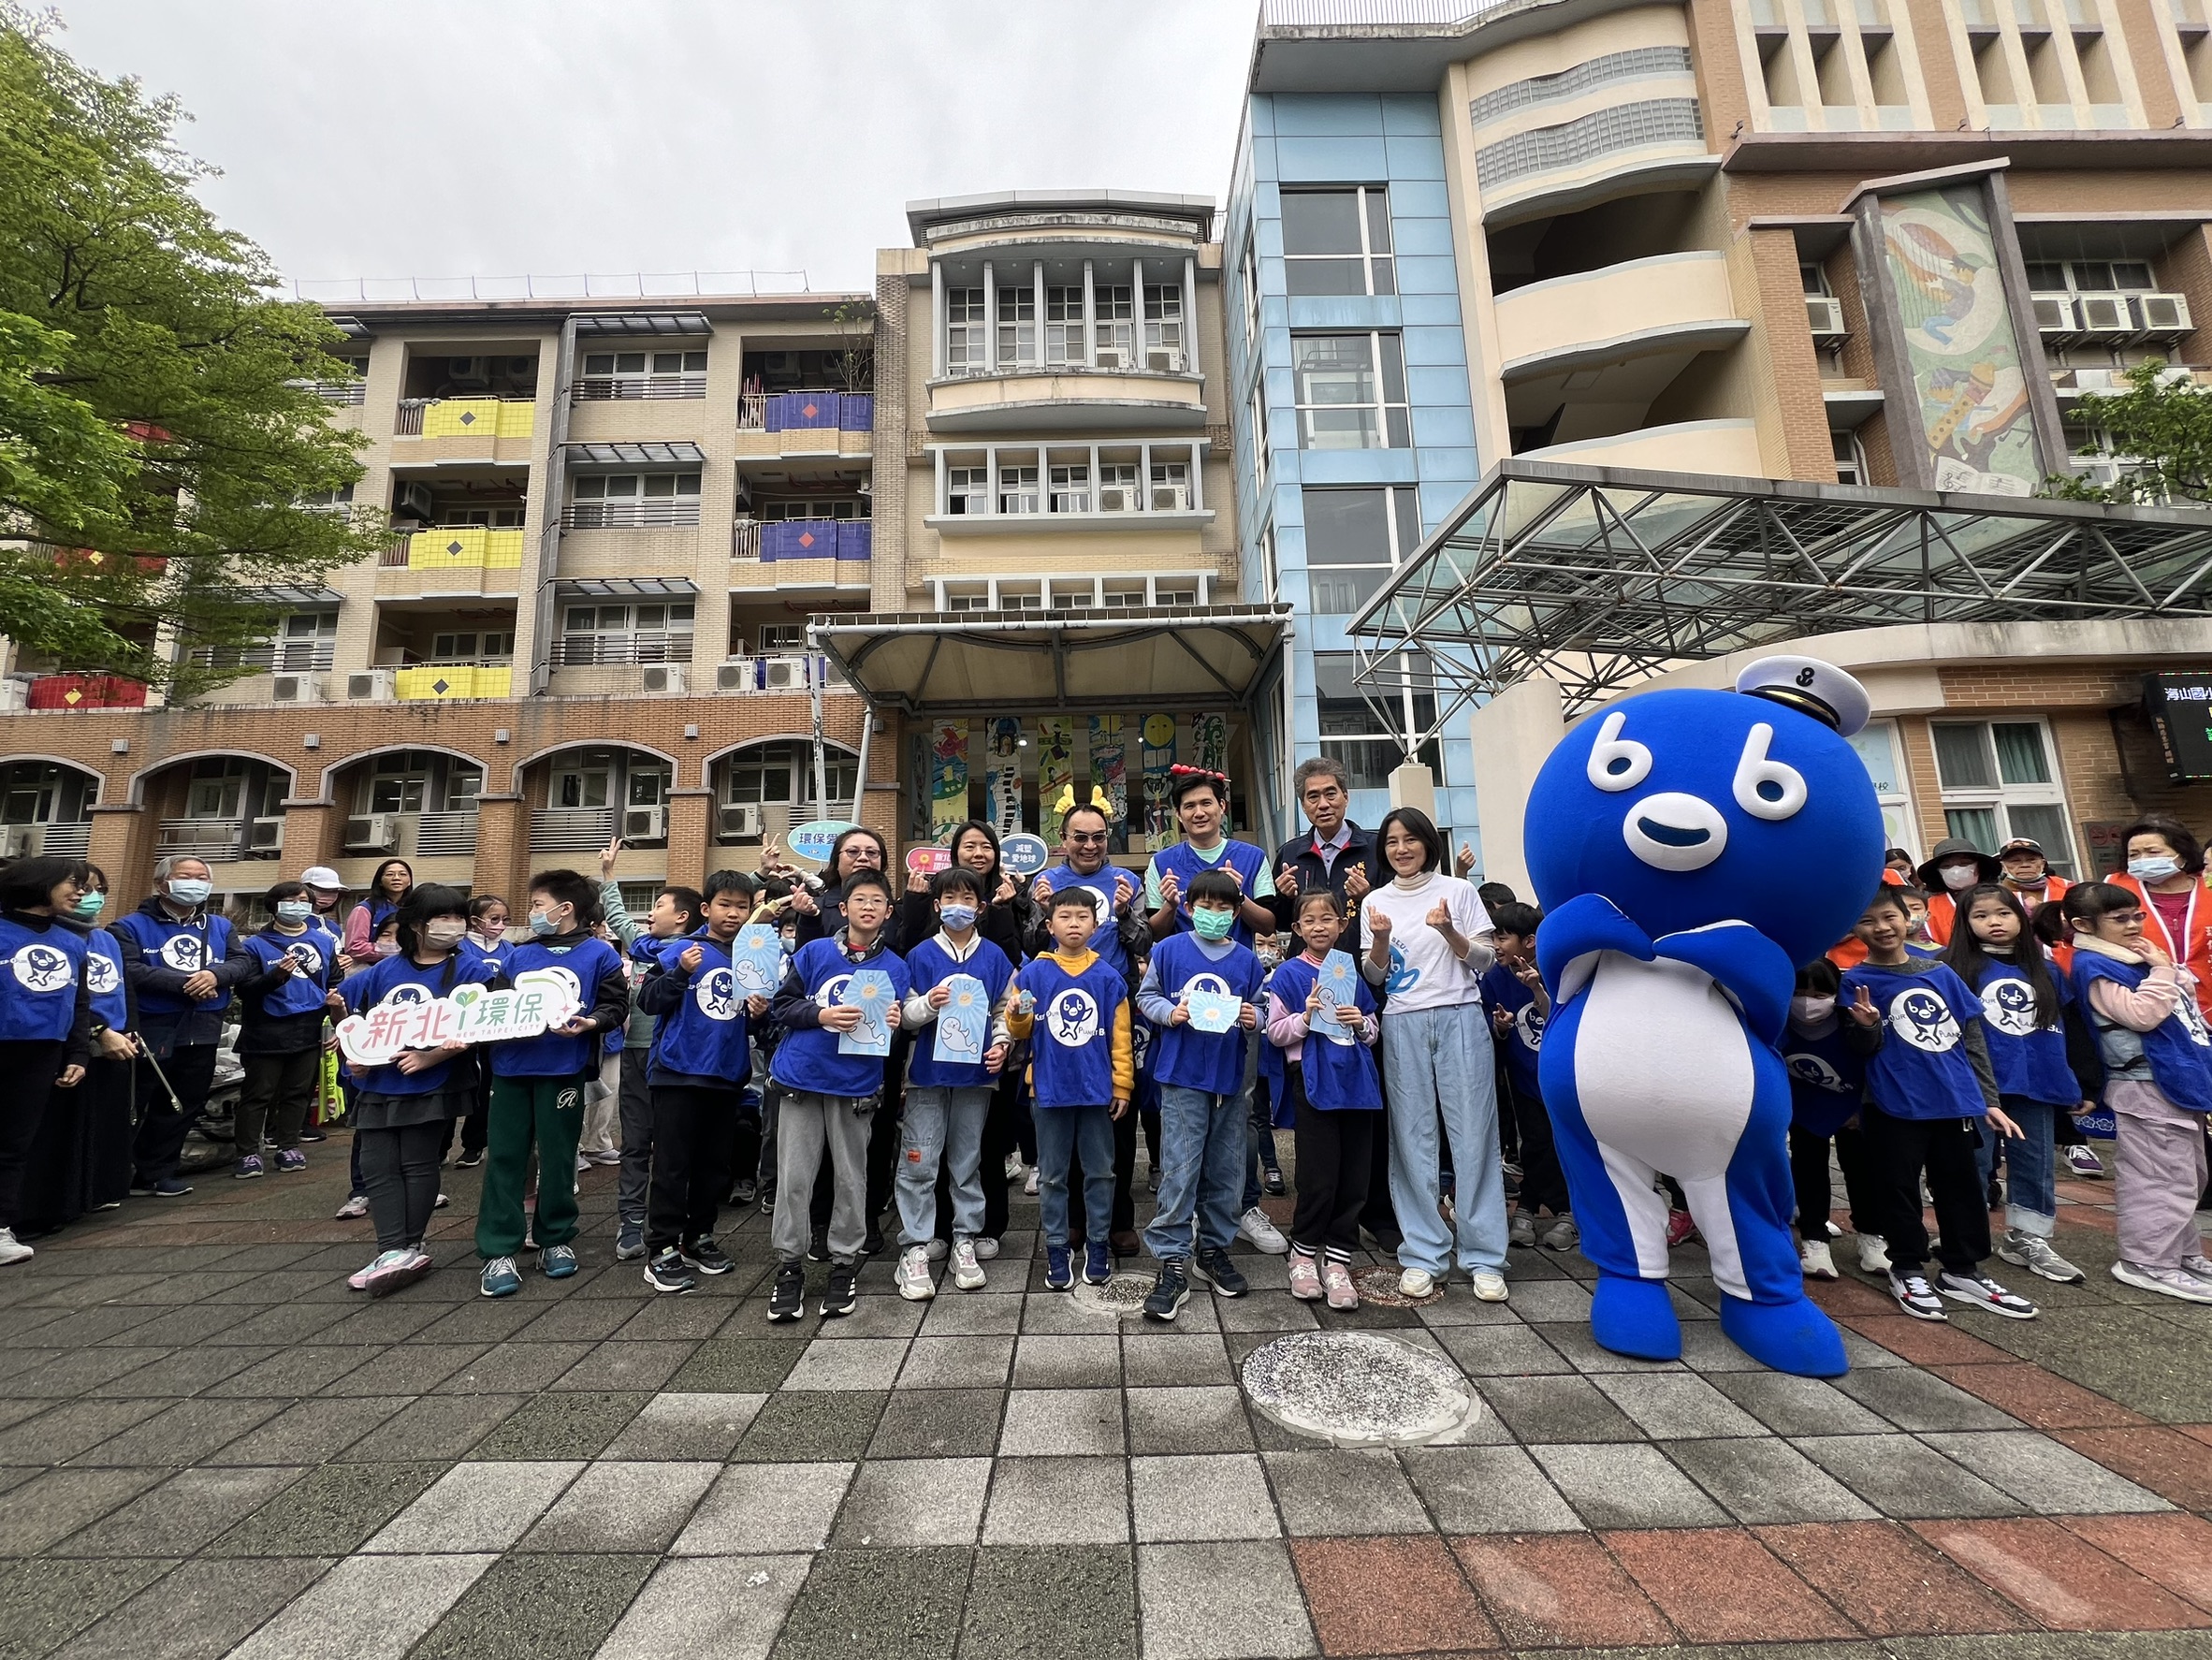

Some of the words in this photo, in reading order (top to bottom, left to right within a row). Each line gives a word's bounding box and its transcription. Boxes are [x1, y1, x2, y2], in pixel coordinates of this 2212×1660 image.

[1011, 853, 1036, 863] 愛地球
[1390, 936, 1410, 954] BLUE
[1046, 1010, 1059, 1018] OUR
[1888, 1013, 1907, 1023] OUR
[481, 1027, 513, 1036] TAIPEI
[518, 1024, 540, 1032] CITY
